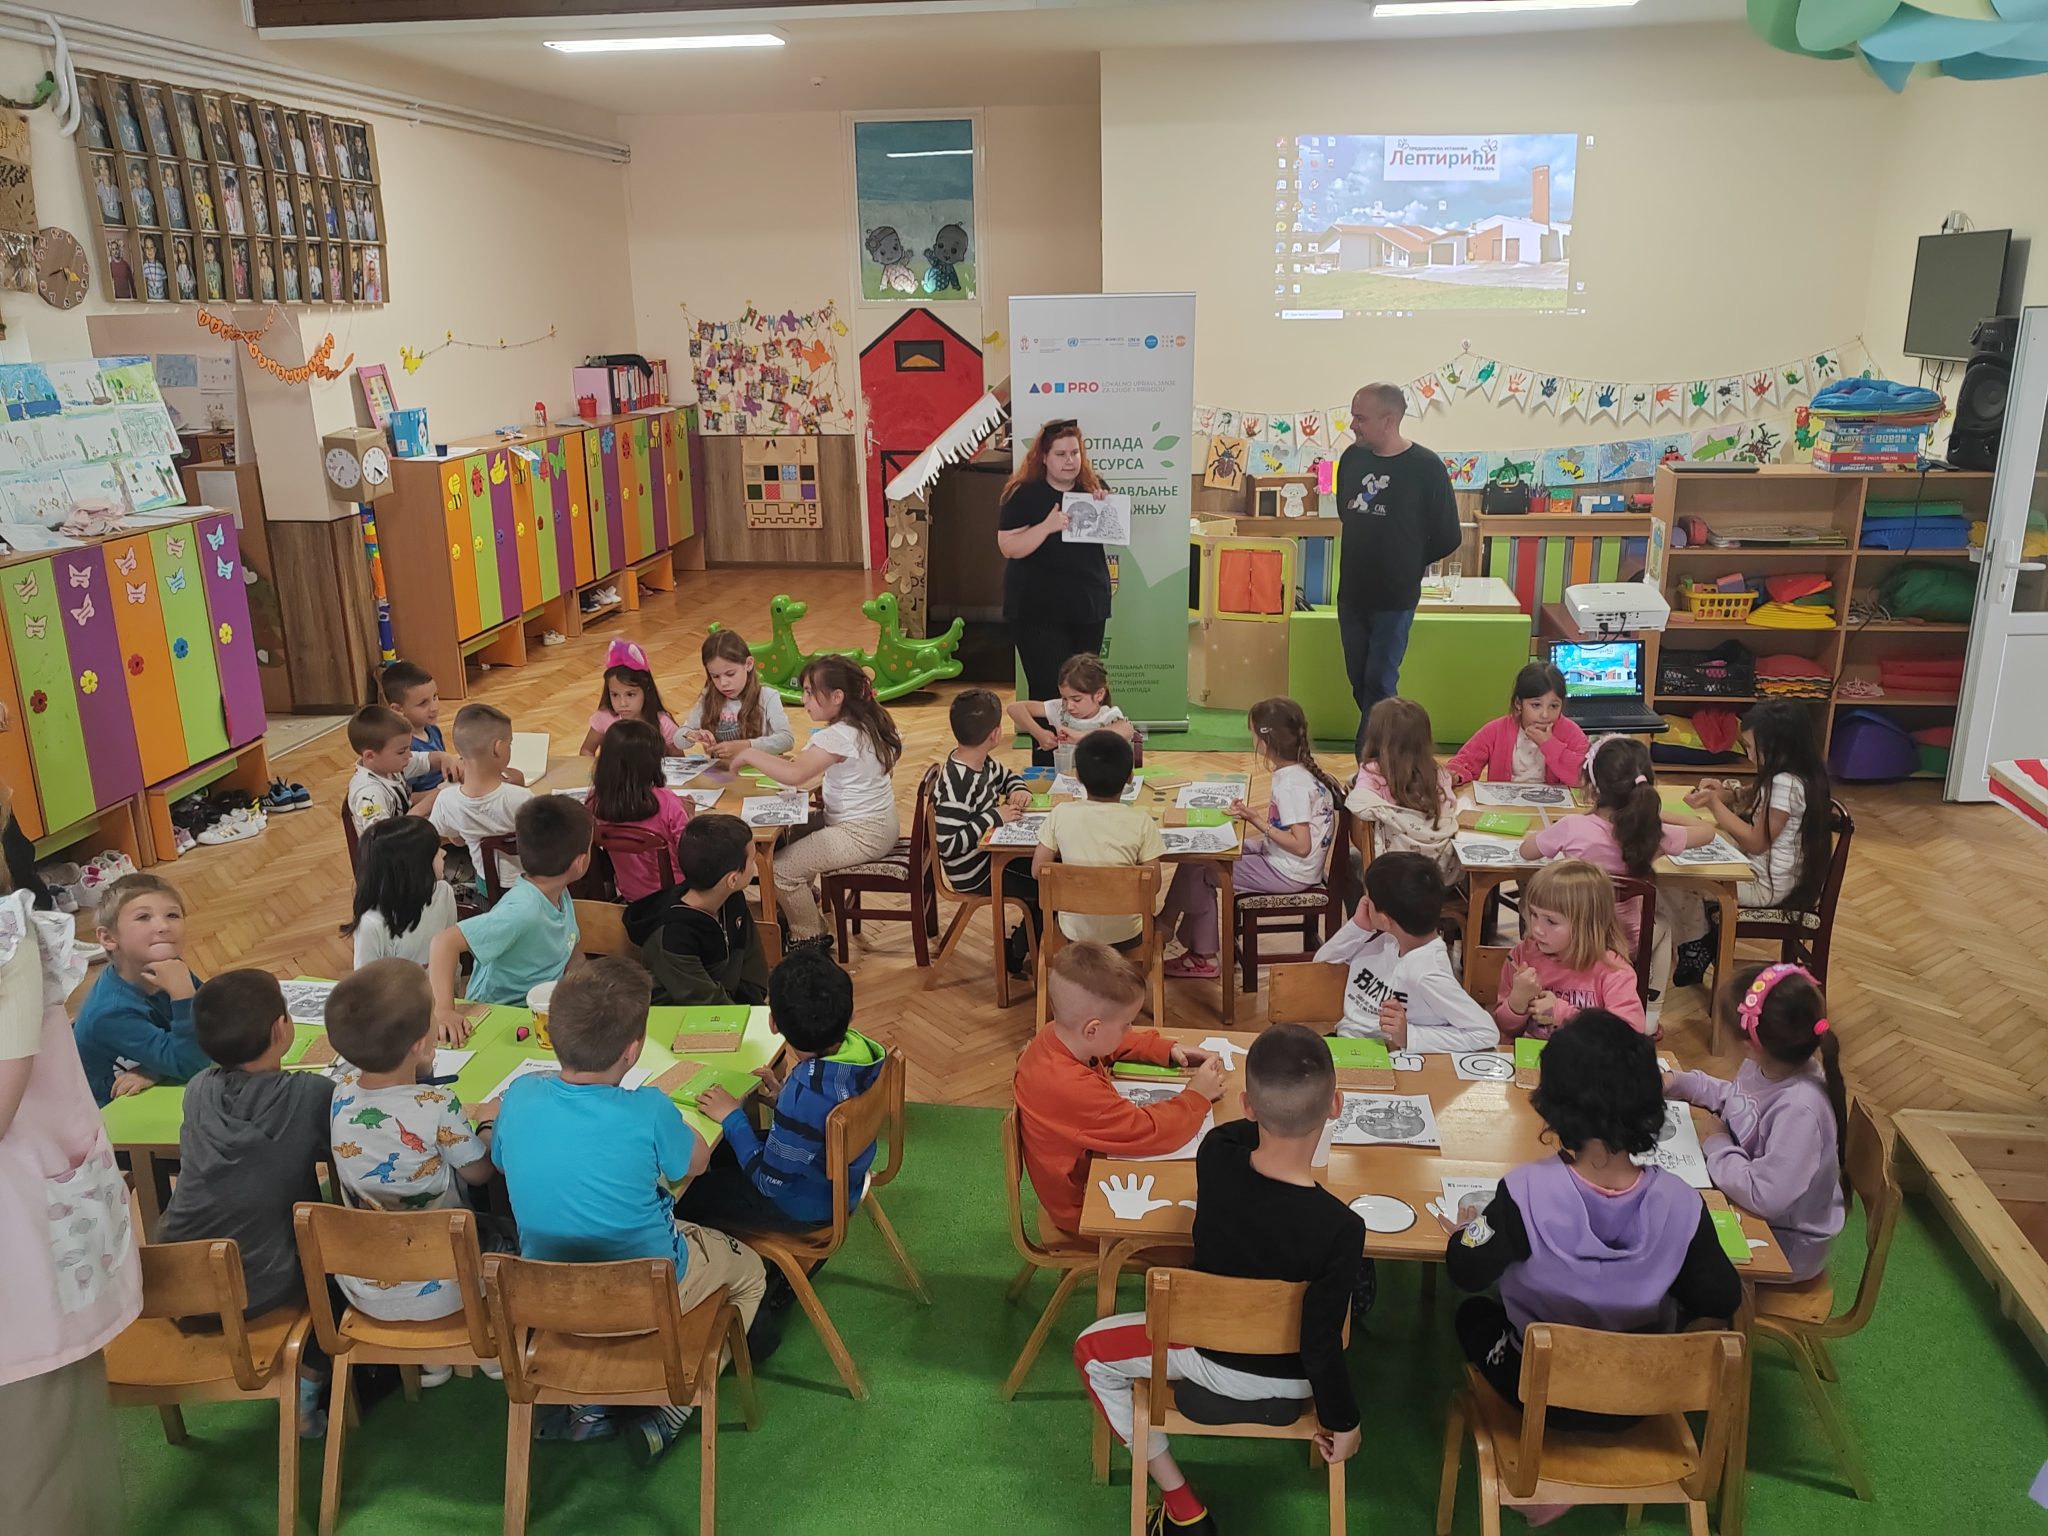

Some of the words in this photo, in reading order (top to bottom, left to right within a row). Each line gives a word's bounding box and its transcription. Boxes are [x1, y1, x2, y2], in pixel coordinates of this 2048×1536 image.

[1390, 149, 1496, 168] Лептирићи
[1068, 382, 1099, 393] PRO
[1084, 437, 1144, 452] ОТПАДА
[1091, 458, 1144, 471] ЕСУРСА
[1131, 504, 1167, 515] ЖЊУ
